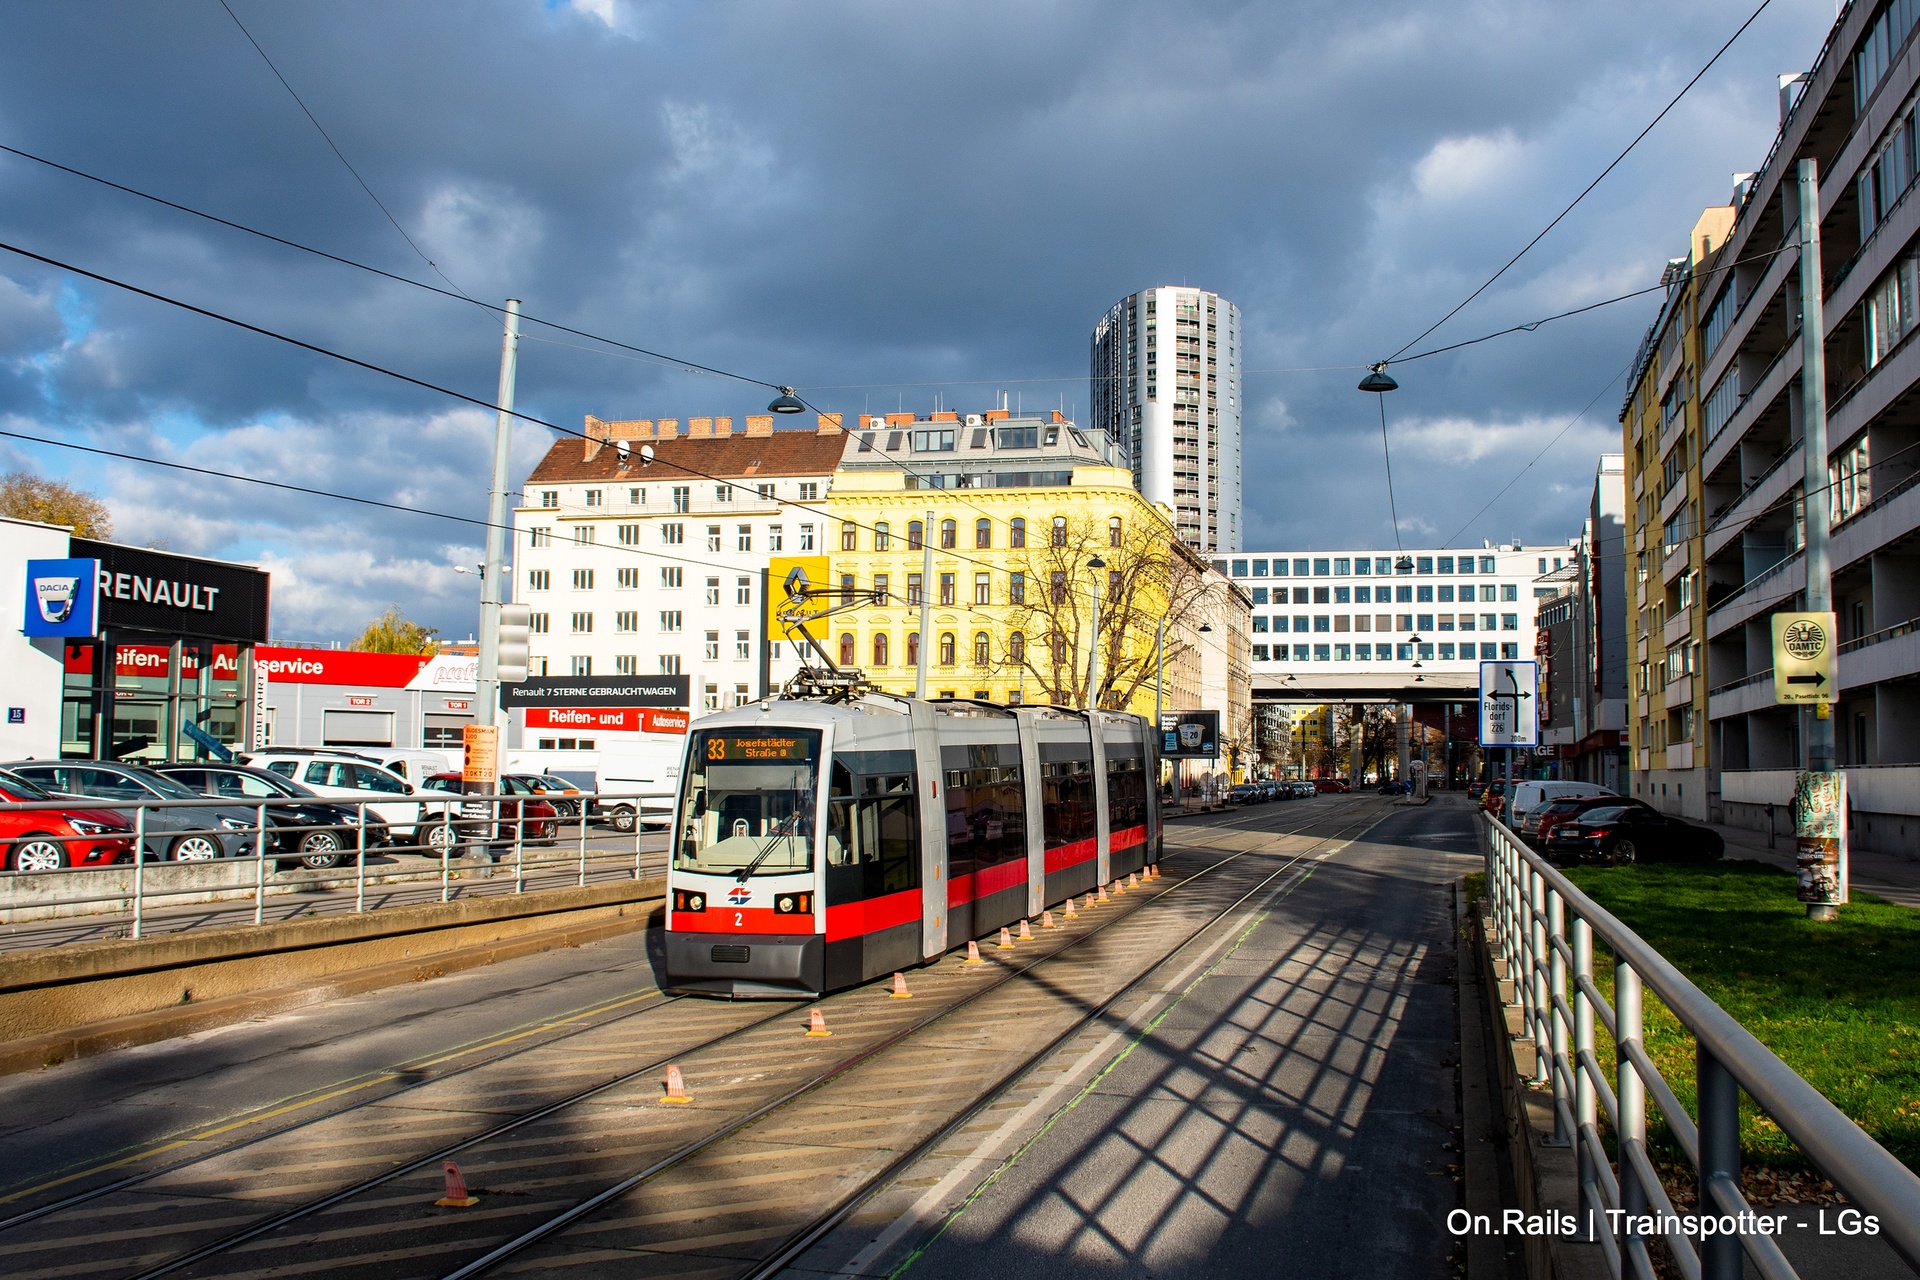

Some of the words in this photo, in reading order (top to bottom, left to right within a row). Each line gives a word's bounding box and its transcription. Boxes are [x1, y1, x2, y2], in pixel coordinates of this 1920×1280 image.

[40, 584, 69, 592] DACIA
[100, 570, 219, 611] RENAULT
[116, 648, 167, 667] eifen-
[512, 687, 545, 697] Renault
[547, 688, 552, 696] 7
[553, 688, 587, 696] STERNE
[589, 687, 676, 696] GEBRAUCHTWAGEN
[1484, 702, 1513, 711] Florids-
[13, 709, 21, 718] 15
[255, 675, 264, 750] ROBEFAHRT
[1490, 712, 1505, 720] dorf
[549, 709, 596, 724] Reifen-
[599, 712, 624, 725] und
[652, 714, 686, 728] Autoservice
[1491, 724, 1504, 732] 226
[708, 739, 724, 760] 33
[736, 739, 796, 748] Josefstädter
[746, 749, 777, 757] Straße
[735, 912, 743, 926] 2
